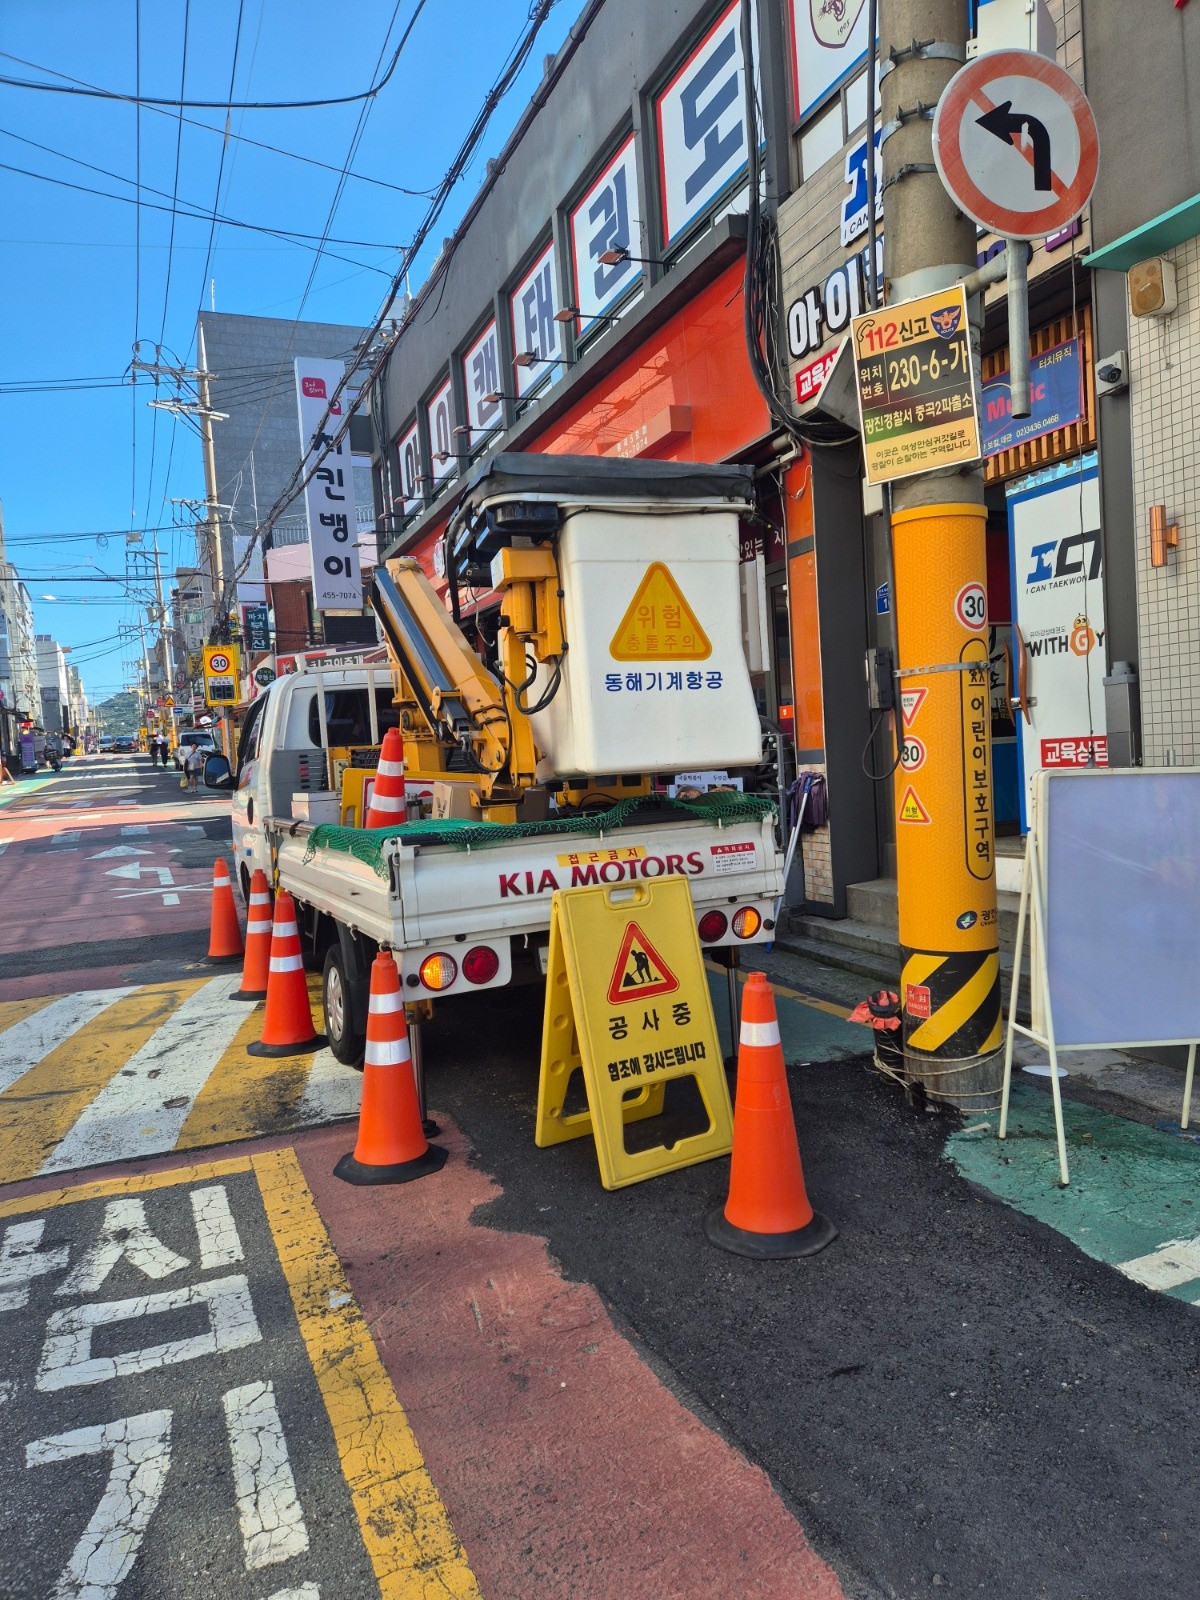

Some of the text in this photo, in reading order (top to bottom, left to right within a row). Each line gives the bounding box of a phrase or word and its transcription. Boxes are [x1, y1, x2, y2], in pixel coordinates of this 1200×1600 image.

[889, 340, 968, 391] 230-6-가
[1038, 346, 1072, 369] 터치뮤직
[860, 363, 883, 382] 위치
[862, 384, 885, 400] 번호
[864, 394, 973, 435] 광진경찰서 중곡2파출소
[311, 432, 352, 579] 치킨뱅이
[322, 592, 357, 600] 455-7074
[1030, 584, 1047, 594] CAN
[637, 605, 681, 629] 위험
[964, 595, 985, 618] 30
[627, 633, 695, 652] 충돌주의
[213, 658, 226, 669] 30
[605, 671, 723, 692] 동해기계항공
[902, 745, 919, 763] 30
[970, 695, 991, 862] 어린이보호구역
[905, 806, 918, 814] 위험
[499, 869, 559, 898] KIA
[571, 851, 705, 888] MOTORS
[607, 1041, 707, 1082] 협조에 감사드립니다
